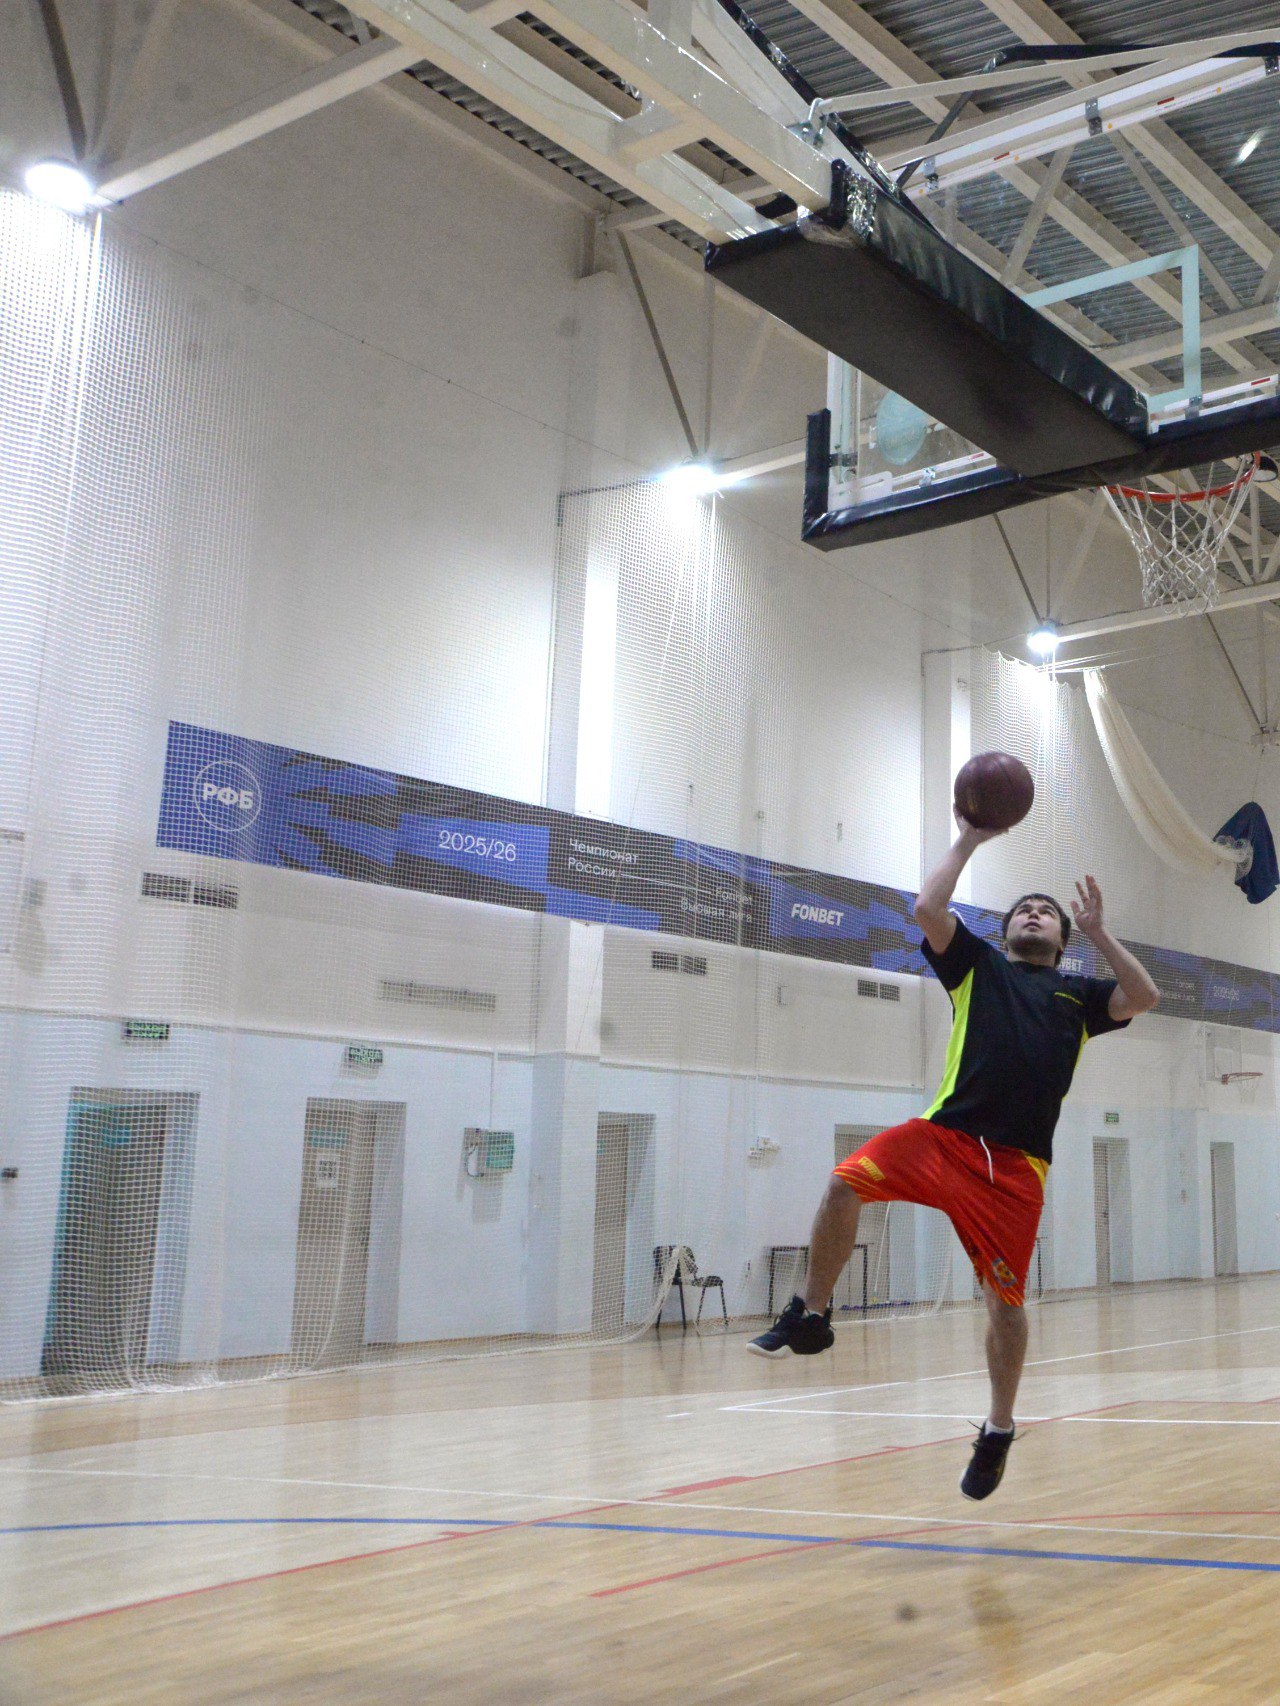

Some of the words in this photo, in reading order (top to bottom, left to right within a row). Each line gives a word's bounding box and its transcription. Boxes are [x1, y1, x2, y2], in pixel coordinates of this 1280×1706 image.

[202, 782, 254, 810] РФБ
[438, 830, 517, 862] 2025/26
[569, 838, 639, 865] Чемпионат
[568, 857, 616, 879] России
[791, 903, 845, 926] FONBET
